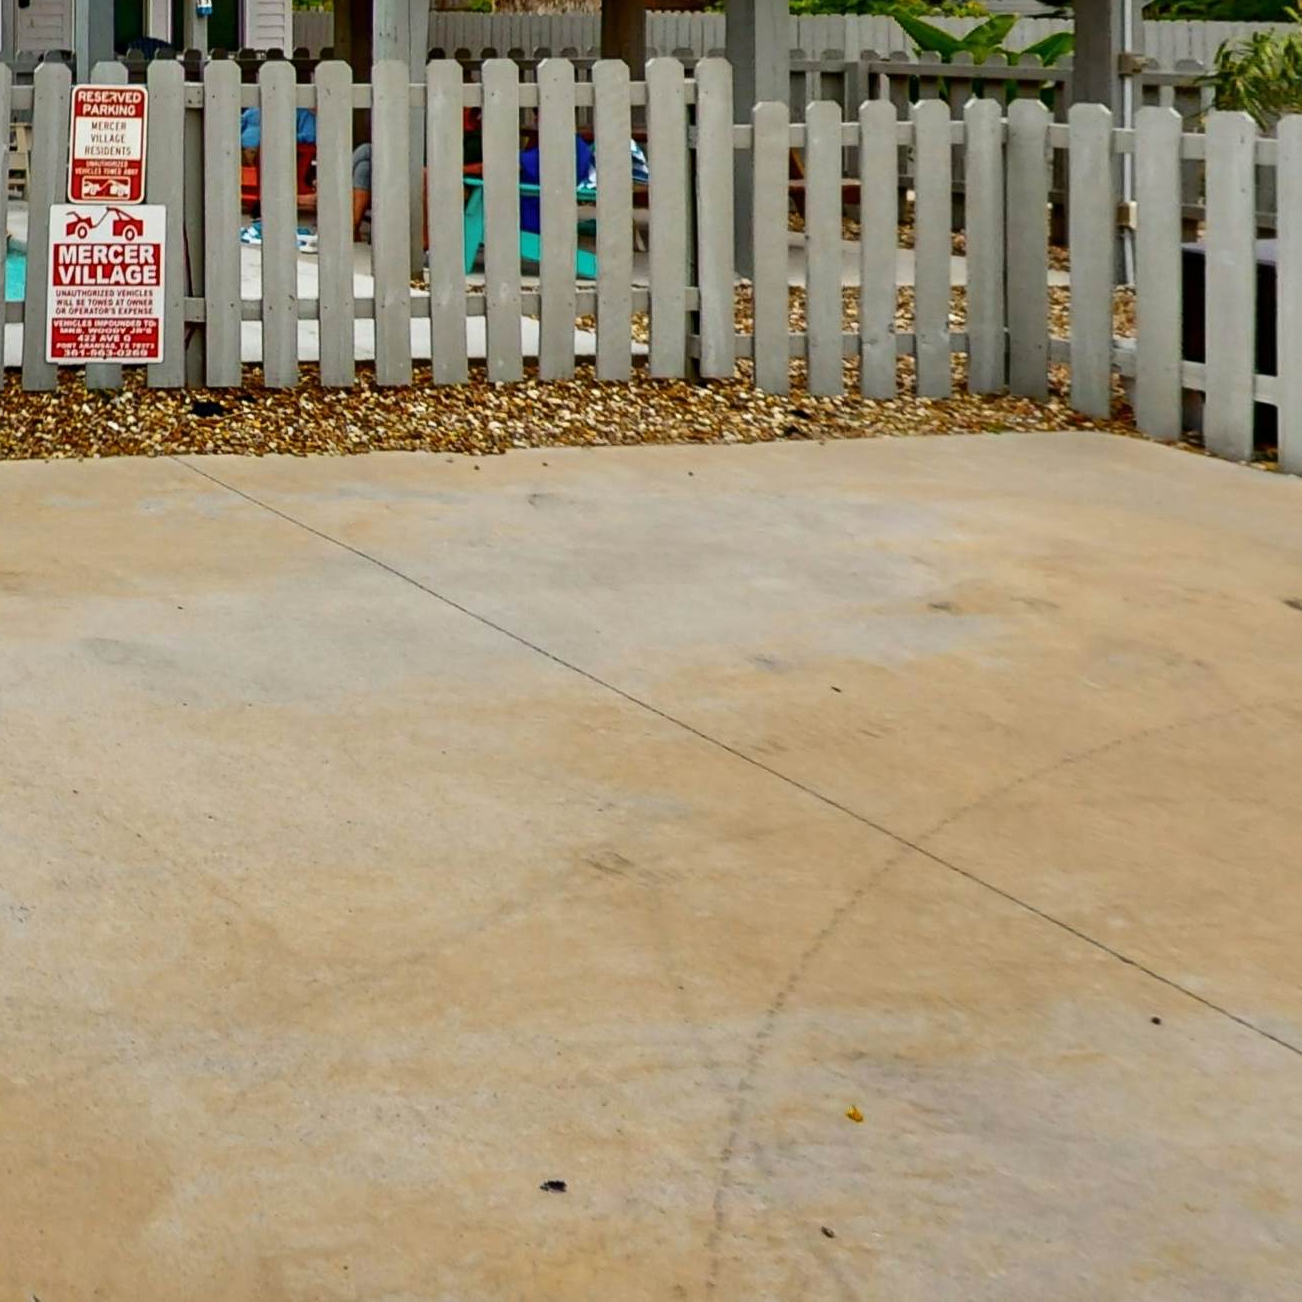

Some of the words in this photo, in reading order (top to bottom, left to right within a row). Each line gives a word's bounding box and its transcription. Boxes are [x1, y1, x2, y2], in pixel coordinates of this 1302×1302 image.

[78, 91, 142, 103] RESERVED
[83, 104, 136, 115] PARKING
[91, 121, 127, 130] MERCER
[90, 134, 125, 143] VILLAGE
[84, 146, 131, 155] RESIDENTS
[58, 245, 155, 264] MERCER
[58, 265, 157, 284] VILLAGE
[99, 334, 120, 342] AVE
